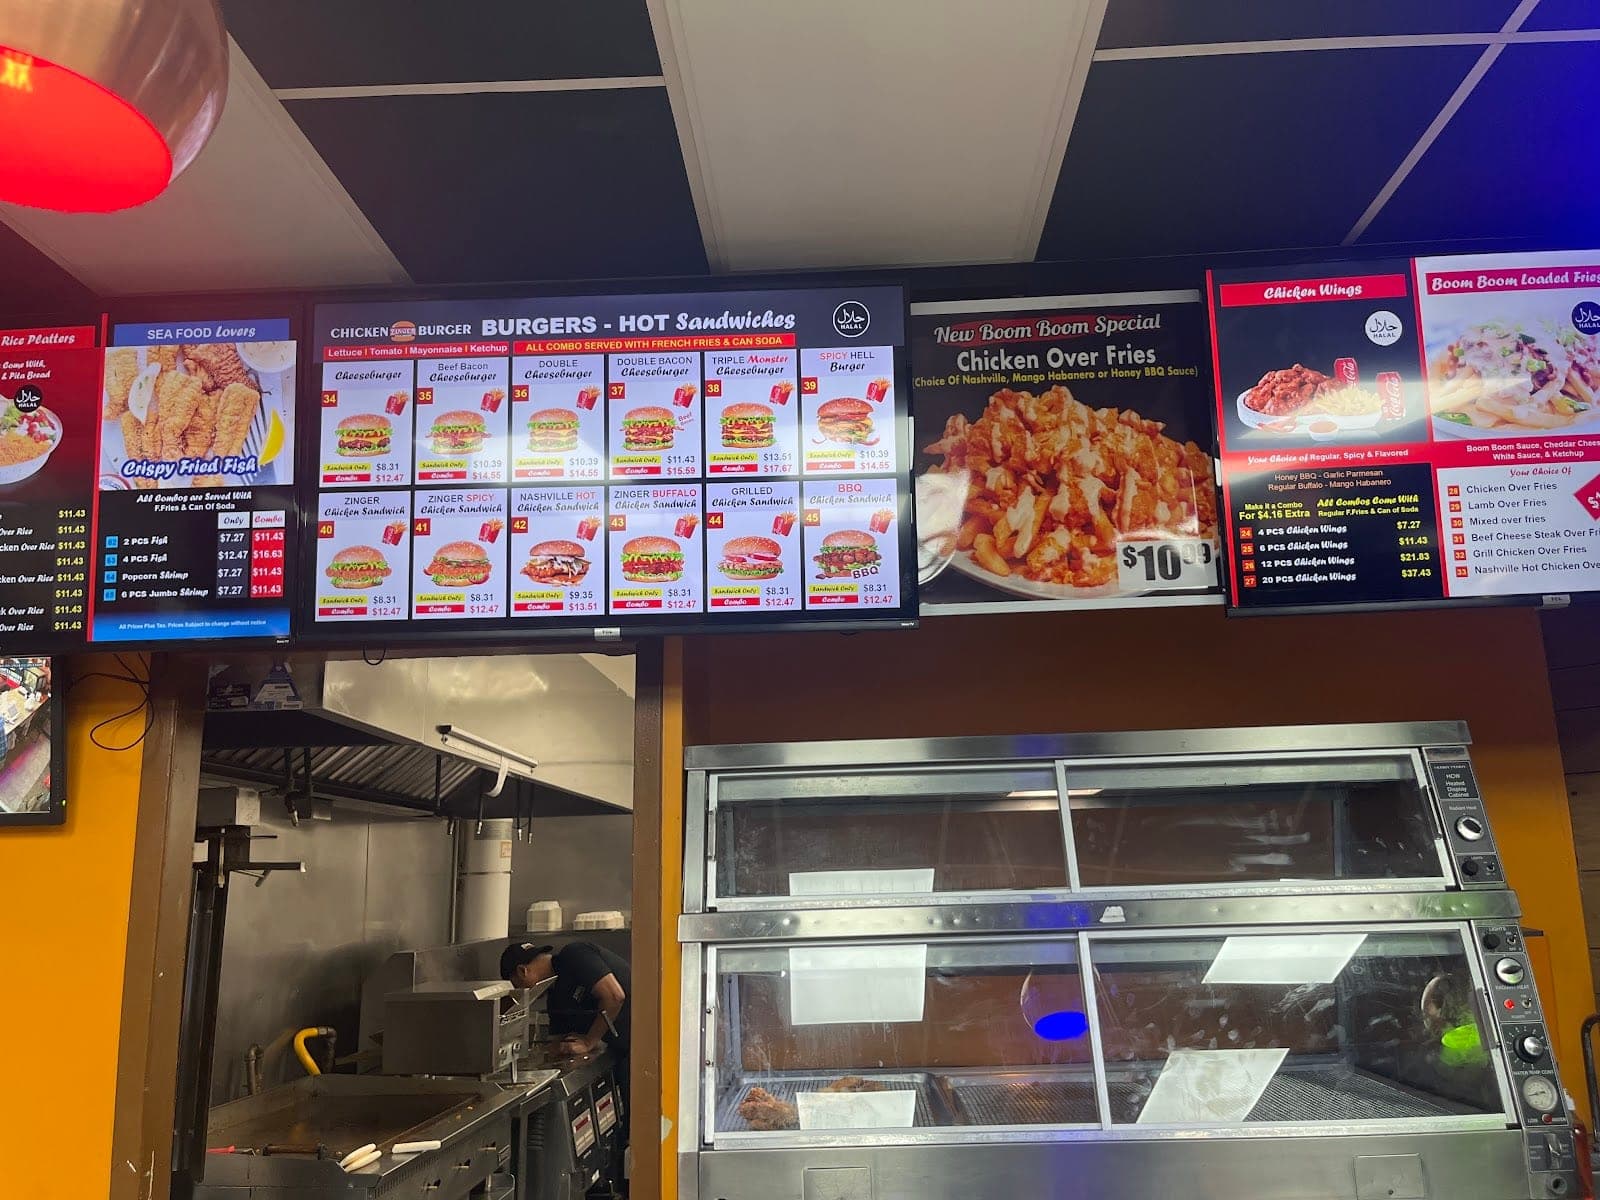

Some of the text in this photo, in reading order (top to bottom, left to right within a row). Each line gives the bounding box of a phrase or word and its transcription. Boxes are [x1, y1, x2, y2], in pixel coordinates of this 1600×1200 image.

[1432, 278, 1473, 291] Boom
[1477, 275, 1517, 288] Boom
[1521, 272, 1569, 285] Loaded
[1264, 284, 1362, 300] Chicken Wings
[481, 316, 597, 336] BURGERS
[619, 314, 669, 332] HOT
[676, 310, 795, 330] Sandwiches
[147, 326, 255, 339] SEA FOOD Lovers
[331, 327, 388, 338] CHICKEN
[418, 324, 471, 336] BURGER
[934, 314, 1160, 344] New Boom Boom Special
[1, 333, 75, 346] Rice Platters
[526, 336, 782, 351] ALL COMBO SERVED WITH FRENCH FRIES & CAN SODA
[328, 344, 508, 357] Lettuce Tomato Mayonnaise Ketchup
[617, 357, 656, 365] DOUBLE
[747, 354, 788, 363] Monster
[819, 352, 848, 360] SPICY
[957, 344, 1156, 372] Chicken Over Fries
[438, 363, 488, 371] Beef Bacon
[539, 360, 578, 368] DOUBLE
[830, 362, 865, 372] Burger
[335, 371, 402, 381] Cheeseburger
[525, 370, 592, 380] Cheeseburger
[621, 366, 689, 377] Cheeseburger
[716, 366, 784, 376] Cheeseburger
[430, 373, 496, 383] Cheeseburger
[912, 366, 1198, 388] (Choice Of Nashville, Mango Habanero or Honey BBQ Sauce)
[611, 386, 624, 395] 37
[708, 384, 719, 393] 38
[804, 381, 816, 390] 39
[419, 392, 432, 400] 35
[514, 389, 527, 398] 36
[323, 395, 336, 403] 34
[124, 457, 255, 478] Crispy Fried Fish
[652, 489, 697, 497] BUFFALO
[838, 484, 862, 492] BBQ
[1466, 485, 1505, 494] Chicken
[1534, 482, 1557, 490] Fries
[345, 497, 380, 505] ZINGER
[428, 494, 494, 503] ZINGER SPICY
[712, 498, 794, 507] Chicken Sandwich
[810, 494, 891, 505] Chicken Sandwich
[1523, 499, 1547, 507] Fries
[421, 504, 502, 515] Chicken Sandwich
[518, 502, 599, 512] Chicken Sandwich
[615, 500, 696, 510] Chicken Sandwich
[325, 507, 405, 517] Chicken Sandwich
[1239, 510, 1310, 520] For $4.16 Extra
[224, 515, 282, 525] Only Combo
[611, 518, 624, 527] 43
[709, 516, 721, 525] 44
[806, 513, 819, 522] 45
[1525, 515, 1546, 523] fries
[416, 523, 427, 532] 41
[514, 520, 526, 529] 42
[1397, 521, 1420, 530] $7.27
[320, 526, 332, 534] 40
[132, 537, 148, 545] PCS
[151, 536, 168, 545] Fish
[220, 533, 244, 542] $7.27
[255, 533, 284, 541] $11.43
[1399, 537, 1428, 545] $11.43
[150, 554, 167, 562] Fish
[218, 550, 248, 560] $12.47
[1473, 550, 1493, 558] Grill
[1538, 547, 1561, 555] Over
[122, 568, 282, 581] Popcorn Shrimp $7.27 $11.43
[853, 567, 879, 579] BBQ
[1402, 569, 1431, 578] $37.43
[180, 589, 208, 597] Shrimp
[218, 586, 242, 595] $7.27
[252, 586, 281, 594] $11.43
[470, 605, 498, 613] $12.47
